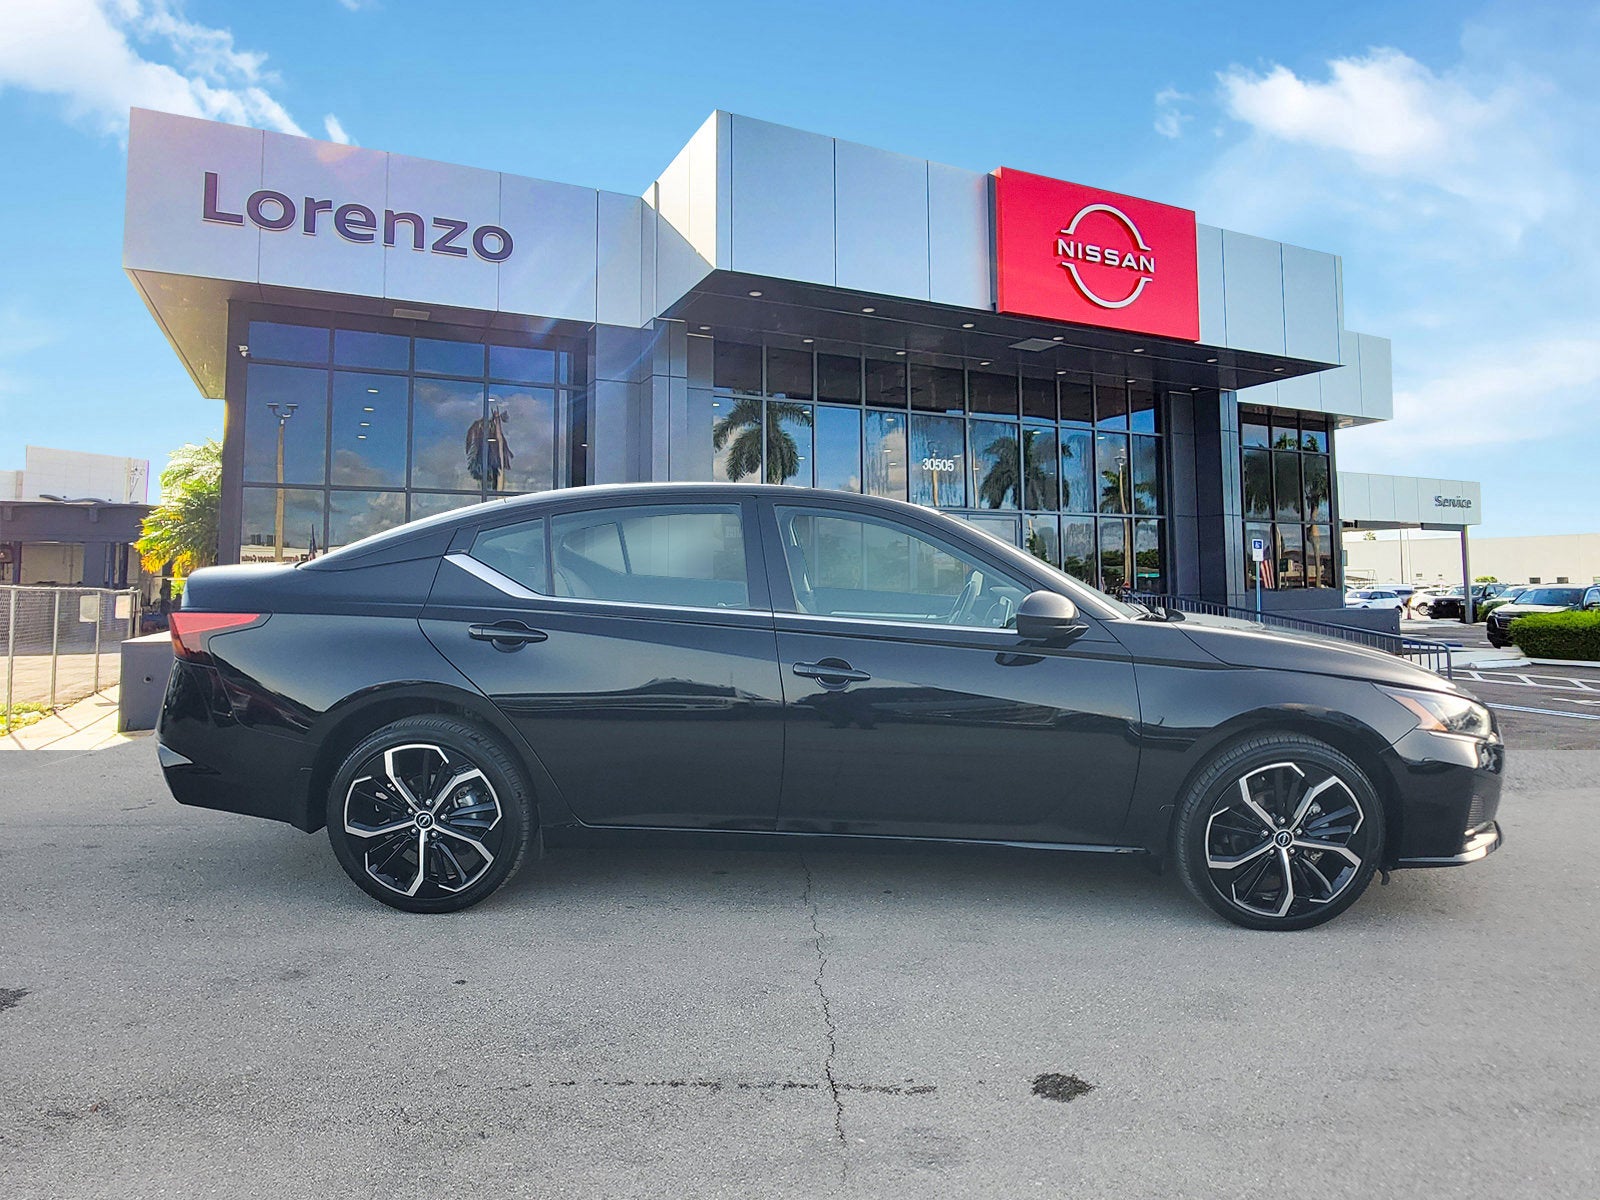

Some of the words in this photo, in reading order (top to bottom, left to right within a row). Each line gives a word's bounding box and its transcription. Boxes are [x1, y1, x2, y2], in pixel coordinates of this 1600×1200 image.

[202, 171, 514, 262] Lorenzo
[1057, 238, 1155, 273] NISSAN
[922, 457, 955, 471] 30505
[1434, 495, 1472, 508] Service
